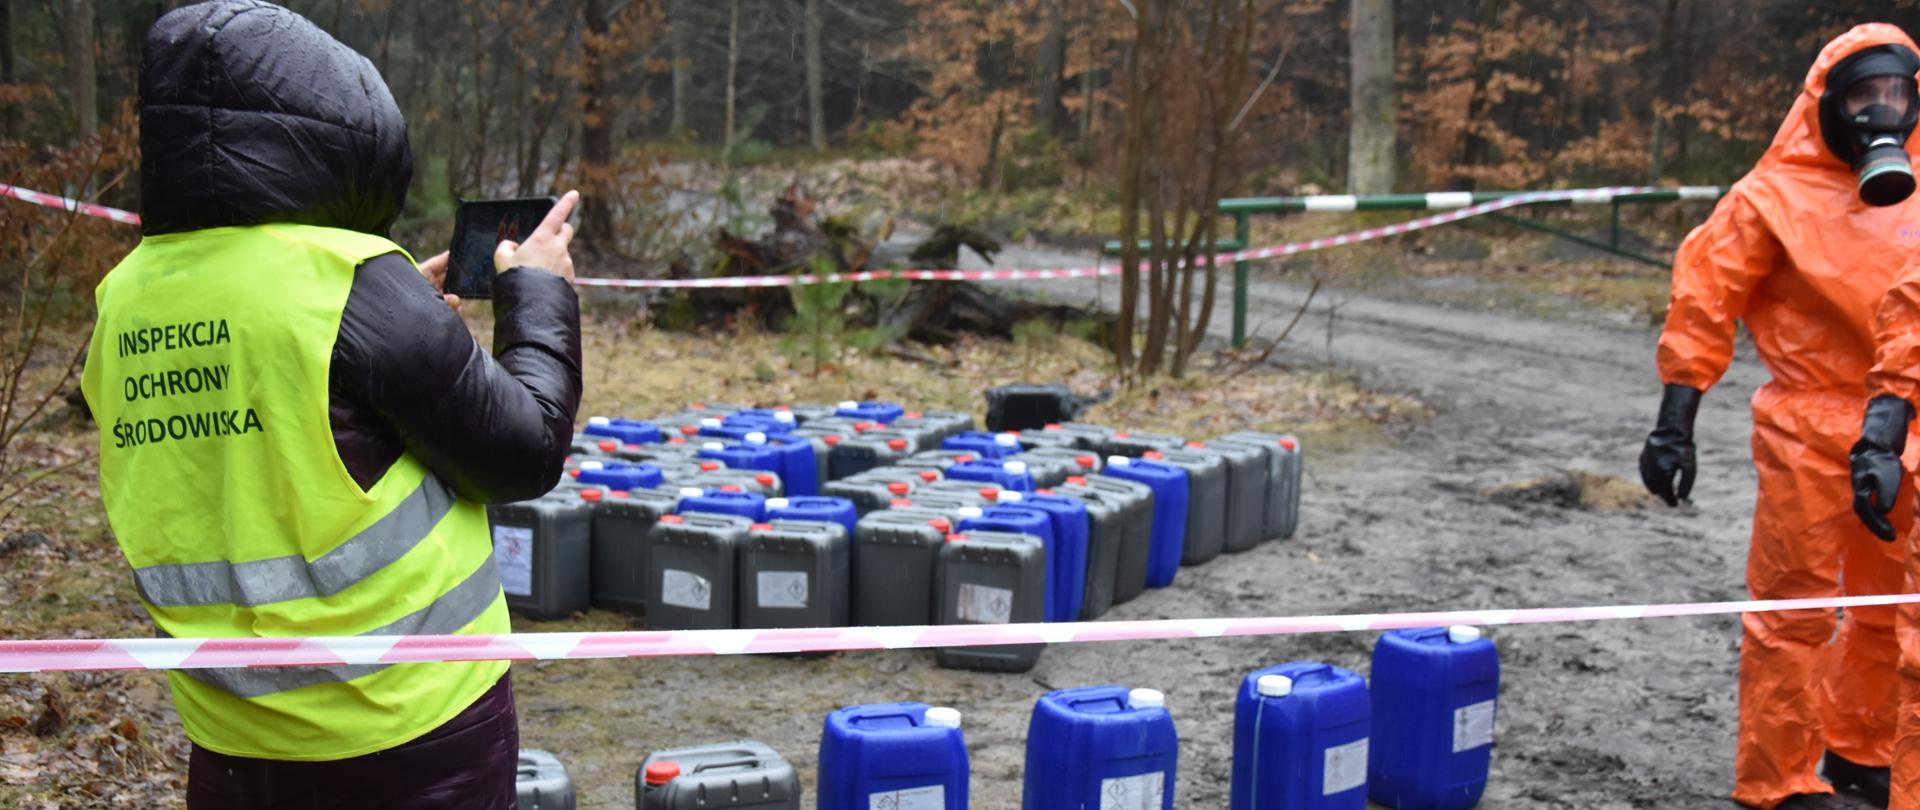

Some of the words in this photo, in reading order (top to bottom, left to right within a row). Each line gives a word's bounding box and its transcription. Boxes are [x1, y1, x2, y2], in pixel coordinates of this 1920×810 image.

[118, 319, 231, 358] INSPEKCJA
[124, 364, 230, 402] OCHRONY
[112, 407, 264, 448] ŚRODOWISKA
